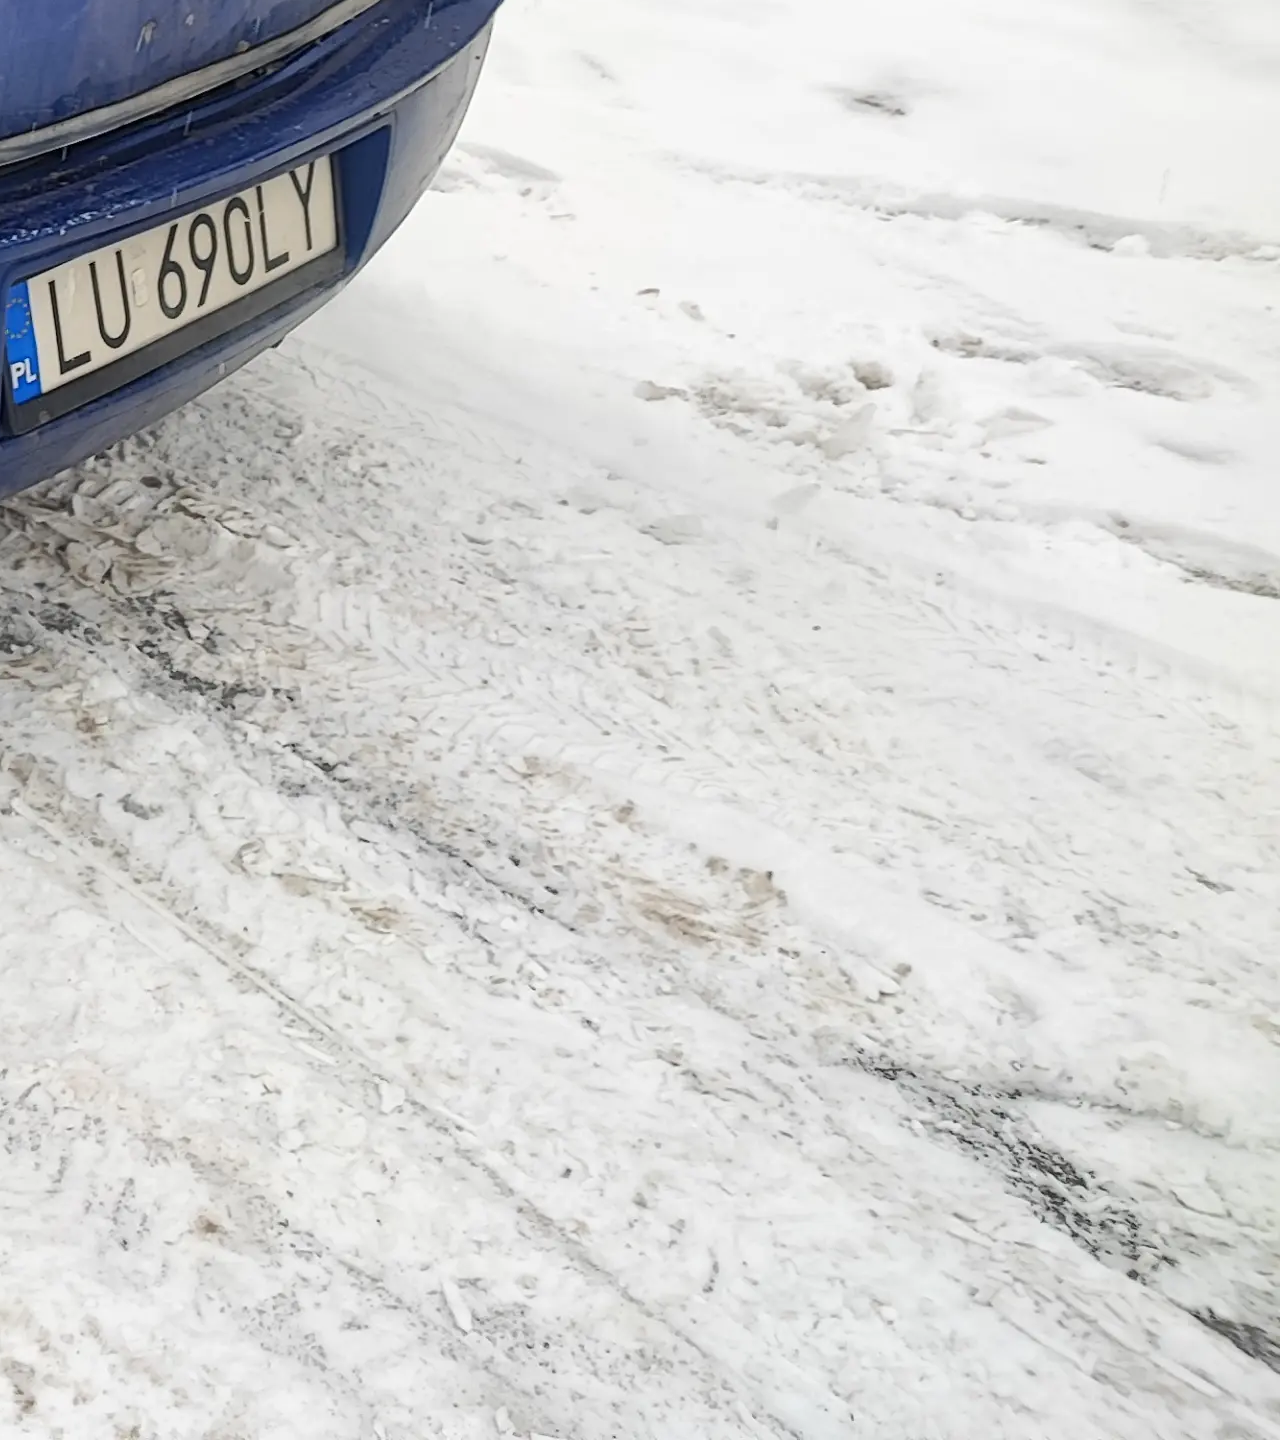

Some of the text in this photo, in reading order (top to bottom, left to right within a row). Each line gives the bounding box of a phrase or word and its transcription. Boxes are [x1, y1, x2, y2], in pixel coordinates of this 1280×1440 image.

[48, 161, 316, 376] LU 690LY
[9, 357, 37, 389] PL
